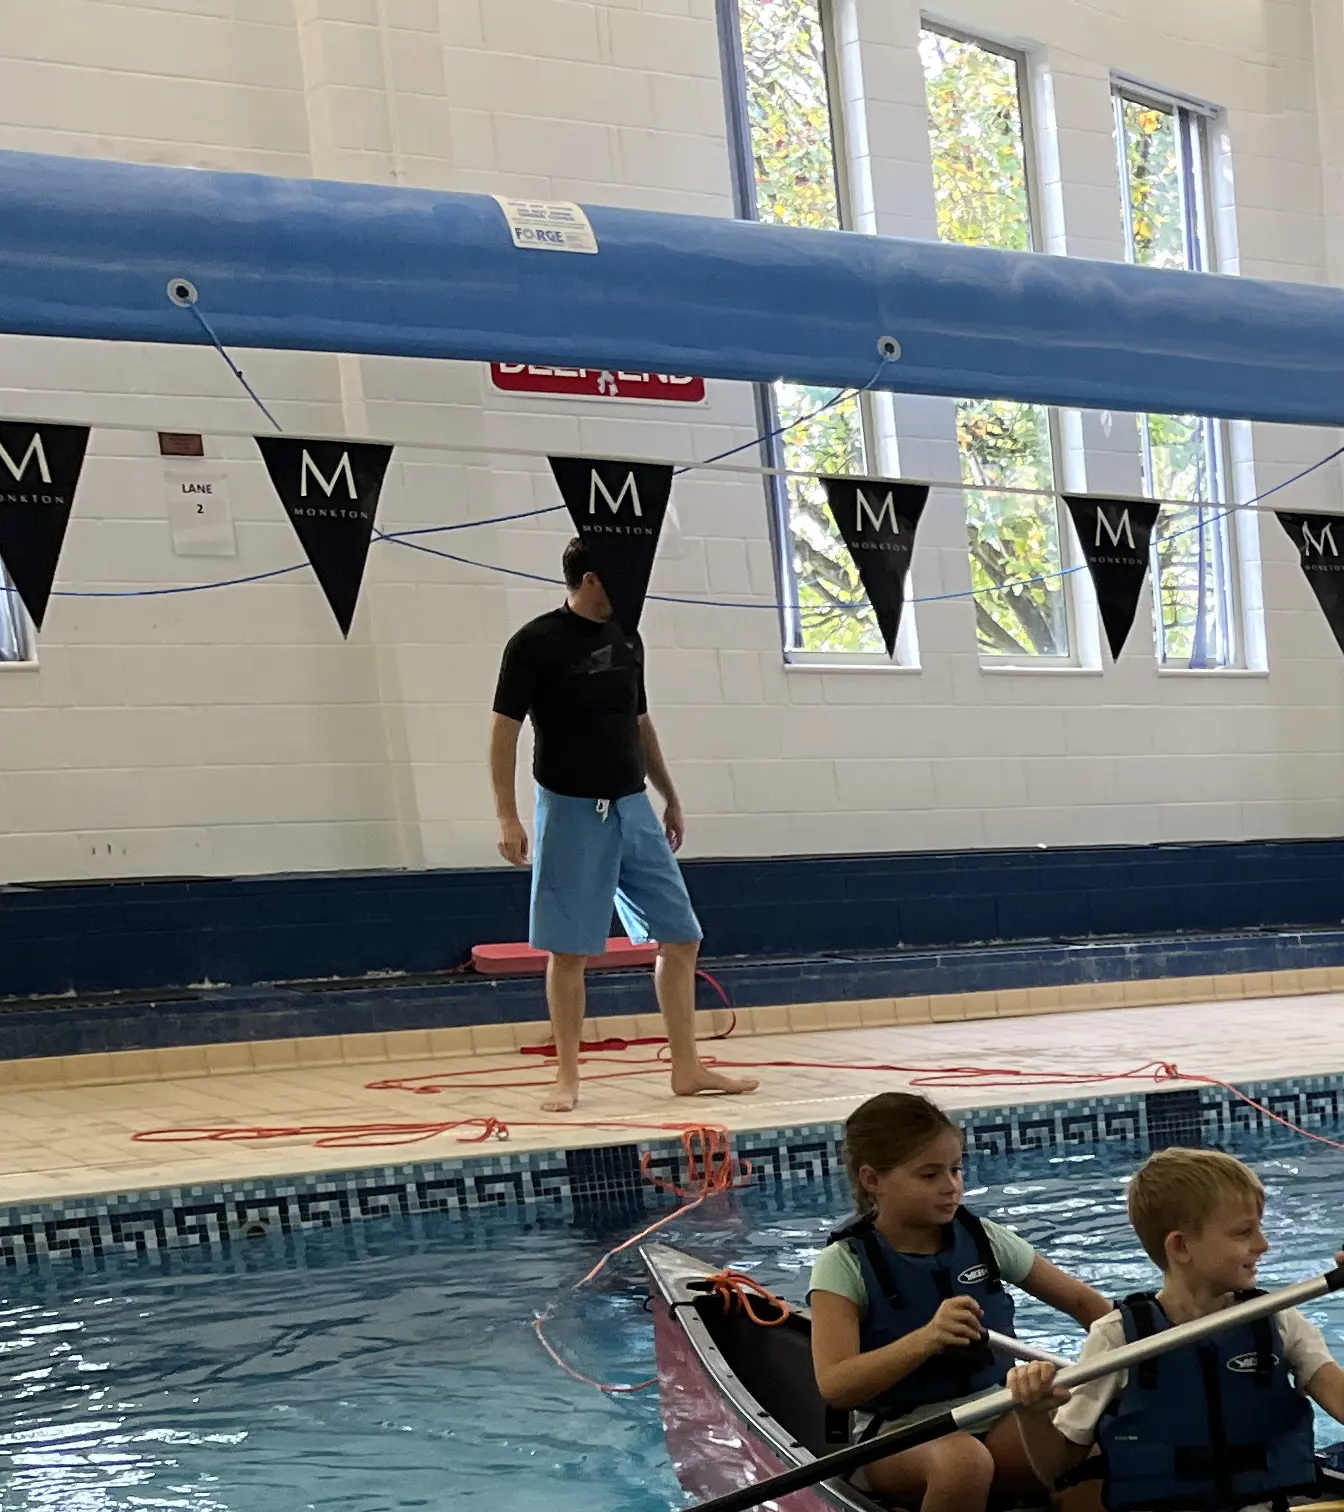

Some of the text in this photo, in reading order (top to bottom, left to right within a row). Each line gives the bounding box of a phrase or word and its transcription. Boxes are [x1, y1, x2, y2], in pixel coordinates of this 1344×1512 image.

[514, 227, 564, 243] FORGE
[301, 448, 358, 499] M
[181, 483, 213, 494] LANE
[589, 468, 643, 517] M
[197, 504, 204, 514] 2
[293, 508, 369, 519] MONKTON
[856, 488, 899, 534] M
[582, 524, 653, 535] MONKTON
[1095, 505, 1136, 549] M
[1301, 520, 1339, 557] M
[851, 541, 908, 552] MONKTON
[1089, 556, 1143, 565] MONKTON
